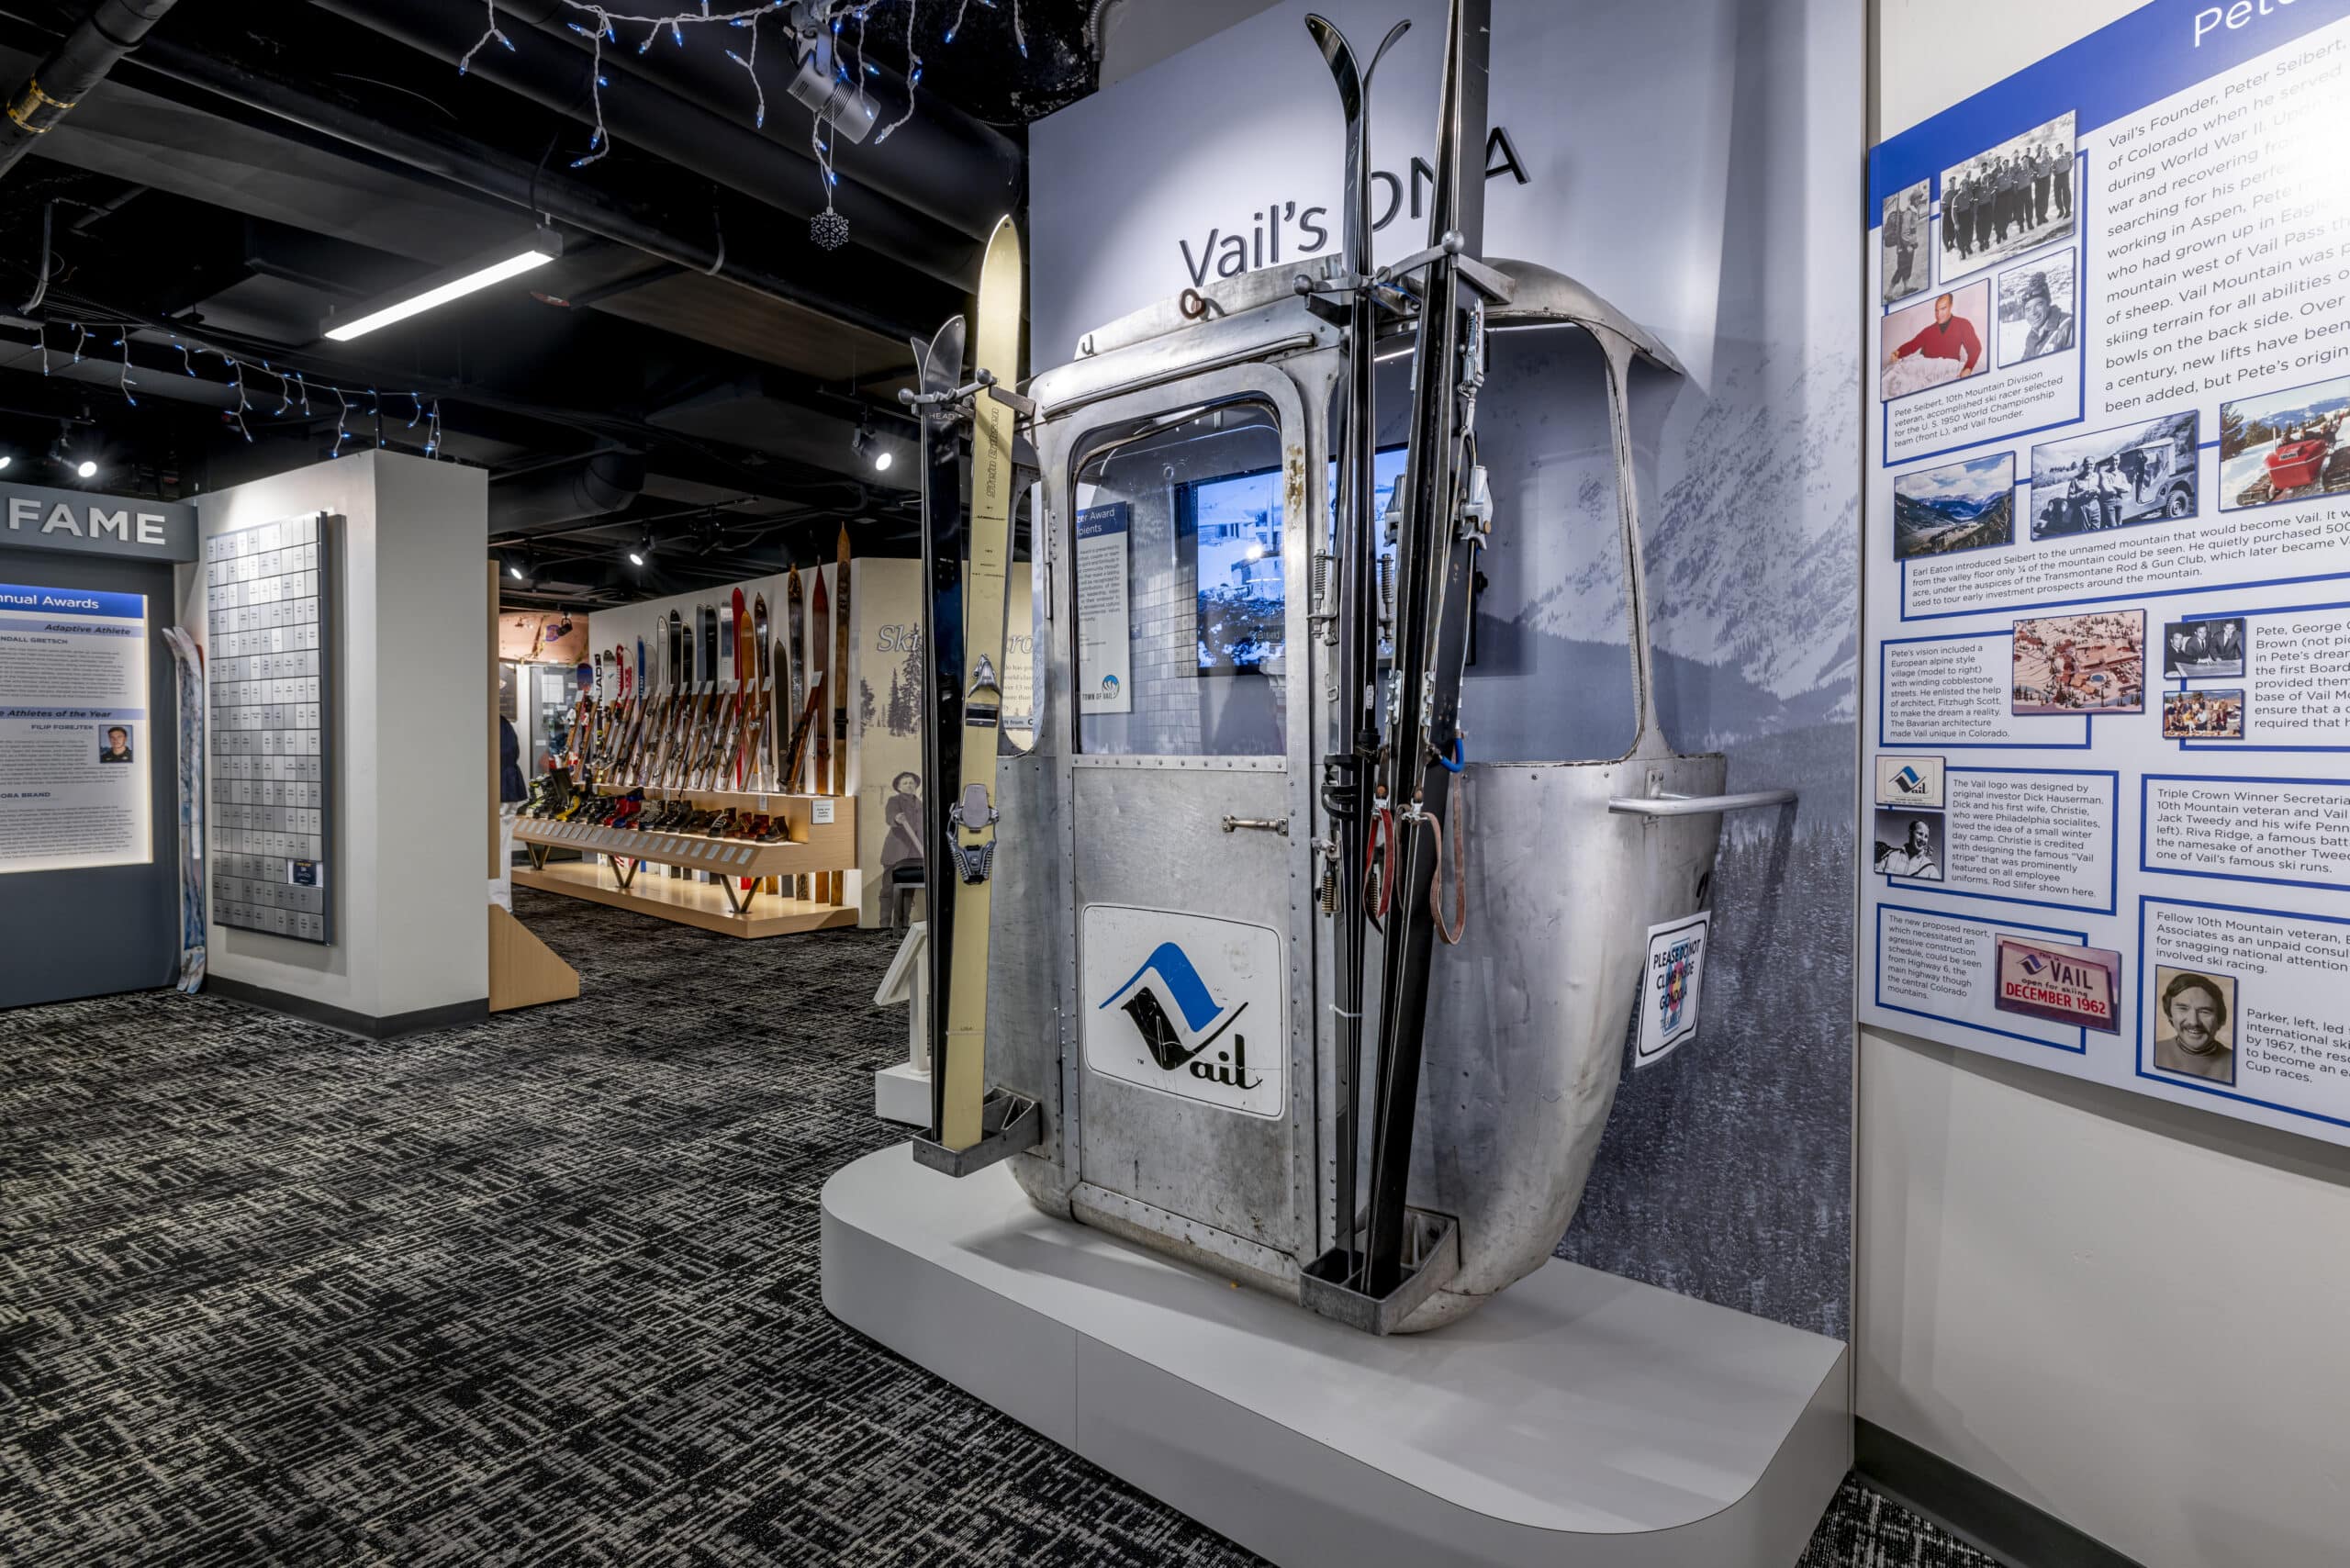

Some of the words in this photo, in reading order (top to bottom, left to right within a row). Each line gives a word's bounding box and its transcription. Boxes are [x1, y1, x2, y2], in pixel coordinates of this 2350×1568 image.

[2109, 127, 2145, 147] Vail's
[2150, 95, 2219, 130] Founder,
[2224, 72, 2270, 98] Peter
[2109, 154, 2123, 171] of
[2128, 128, 2198, 162] Colorado
[2202, 106, 2247, 130] when
[2254, 95, 2275, 110] he
[2279, 62, 2343, 99] served
[1179, 201, 1327, 287] Vail's
[2107, 274, 2177, 303] mountain
[2181, 258, 2219, 278] west
[2224, 249, 2242, 265] of
[2248, 238, 2277, 257] Vail
[2284, 226, 2325, 246] Pass
[2106, 310, 2121, 325] of
[2125, 298, 2173, 319] sheep.
[2179, 284, 2207, 302] Vail
[2212, 262, 2292, 292] Mountain
[2299, 248, 2334, 266] was
[2106, 328, 2148, 347] skiing
[2153, 311, 2203, 333] terrain
[2209, 303, 2232, 318] for
[2237, 294, 2255, 309] all
[2262, 274, 2331, 302] abilities
[2106, 350, 2148, 368] bowls
[2153, 343, 2172, 356] on
[2177, 335, 2203, 349] the
[2208, 321, 2248, 341] back
[2254, 311, 2293, 329] side.
[2300, 296, 2345, 316] Over
[2105, 382, 2113, 391] a
[2118, 366, 2177, 387] century,
[2183, 355, 2215, 371] new
[2221, 346, 2251, 362] lifts
[2256, 334, 2299, 353] have
[2304, 320, 2350, 340] been
[1894, 408, 1912, 418] Pete
[1913, 398, 1943, 412] Seibert,
[1946, 393, 1964, 403] 10th
[1964, 382, 2005, 398] Mountain
[2007, 372, 2043, 386] Division
[2105, 398, 2141, 413] been
[2145, 381, 2199, 403] added,
[2204, 373, 2232, 389] but
[2238, 360, 2289, 381] Pete's
[1894, 415, 1925, 428] veteran,
[1926, 398, 1983, 419] accomplished
[1985, 394, 1997, 404] ski
[1998, 388, 2021, 399] racer
[2023, 377, 2064, 393] selected
[929, 412, 955, 420] HEAD
[9, 497, 165, 545] FAME
[1090, 507, 1114, 521] Award
[1913, 567, 1929, 577] Earl
[1930, 566, 1953, 575] Eaton
[1955, 558, 2001, 570] introduced
[2004, 554, 2036, 564] Seibert
[2038, 552, 2049, 560] to
[2051, 549, 2067, 558] the
[2069, 542, 2116, 555] unnamed
[2119, 535, 2170, 548] mountain
[2173, 531, 2197, 541] that
[2199, 524, 2236, 537] would
[2240, 519, 2291, 532] become
[2296, 512, 2322, 524] Vail.
[2327, 510, 2336, 520] It
[42, 596, 99, 610] Awards
[44, 623, 92, 633] Adaptive
[94, 626, 131, 635] Athlete
[2256, 627, 2288, 635] Pete,
[2291, 623, 2342, 633] George
[1940, 644, 1975, 654] included
[2255, 640, 2298, 649] Brown
[2301, 636, 2330, 647] (not
[2255, 692, 2285, 701] base
[2288, 690, 2302, 701] of
[2306, 690, 2331, 700] Vail
[7, 710, 52, 718] Athletes
[1890, 730, 1912, 738] made
[1929, 730, 1957, 738] unique
[1968, 729, 2010, 737] Colorado.
[1953, 778, 1969, 788] The
[1970, 779, 1986, 788] Vail
[1987, 780, 2009, 790] logo
[2030, 782, 2074, 792] designed
[2076, 784, 2089, 793] by
[2157, 789, 2188, 799] Triple
[2191, 790, 2230, 800] Crown
[2234, 791, 2279, 802] Winner
[2156, 851, 2177, 859] one
[2180, 852, 2192, 860] of
[2196, 853, 2225, 864] Vail's
[2229, 856, 2275, 868] famous
[2278, 860, 2296, 869] ski
[2300, 863, 2333, 873] runs.
[1889, 914, 1903, 924] The
[1922, 922, 1961, 933] proposed
[1963, 928, 1990, 938] resort,
[2156, 912, 2194, 924] Fellow
[2198, 916, 2222, 927] 10th
[2225, 920, 2284, 935] Mountain
[2288, 930, 2341, 944] veteran,
[1653, 948, 1679, 969] PLEASE
[2050, 960, 2093, 990] VAIL
[1887, 985, 1930, 999] mountains.
[2006, 981, 2072, 1008] DECEMBER
[2076, 997, 2106, 1014] 1962
[2021, 978, 2042, 988] open
[2045, 981, 2058, 990] for
[2062, 987, 2087, 999] skiing
[2246, 1060, 2271, 1074] Cup
[2275, 1069, 2312, 1082] races.
